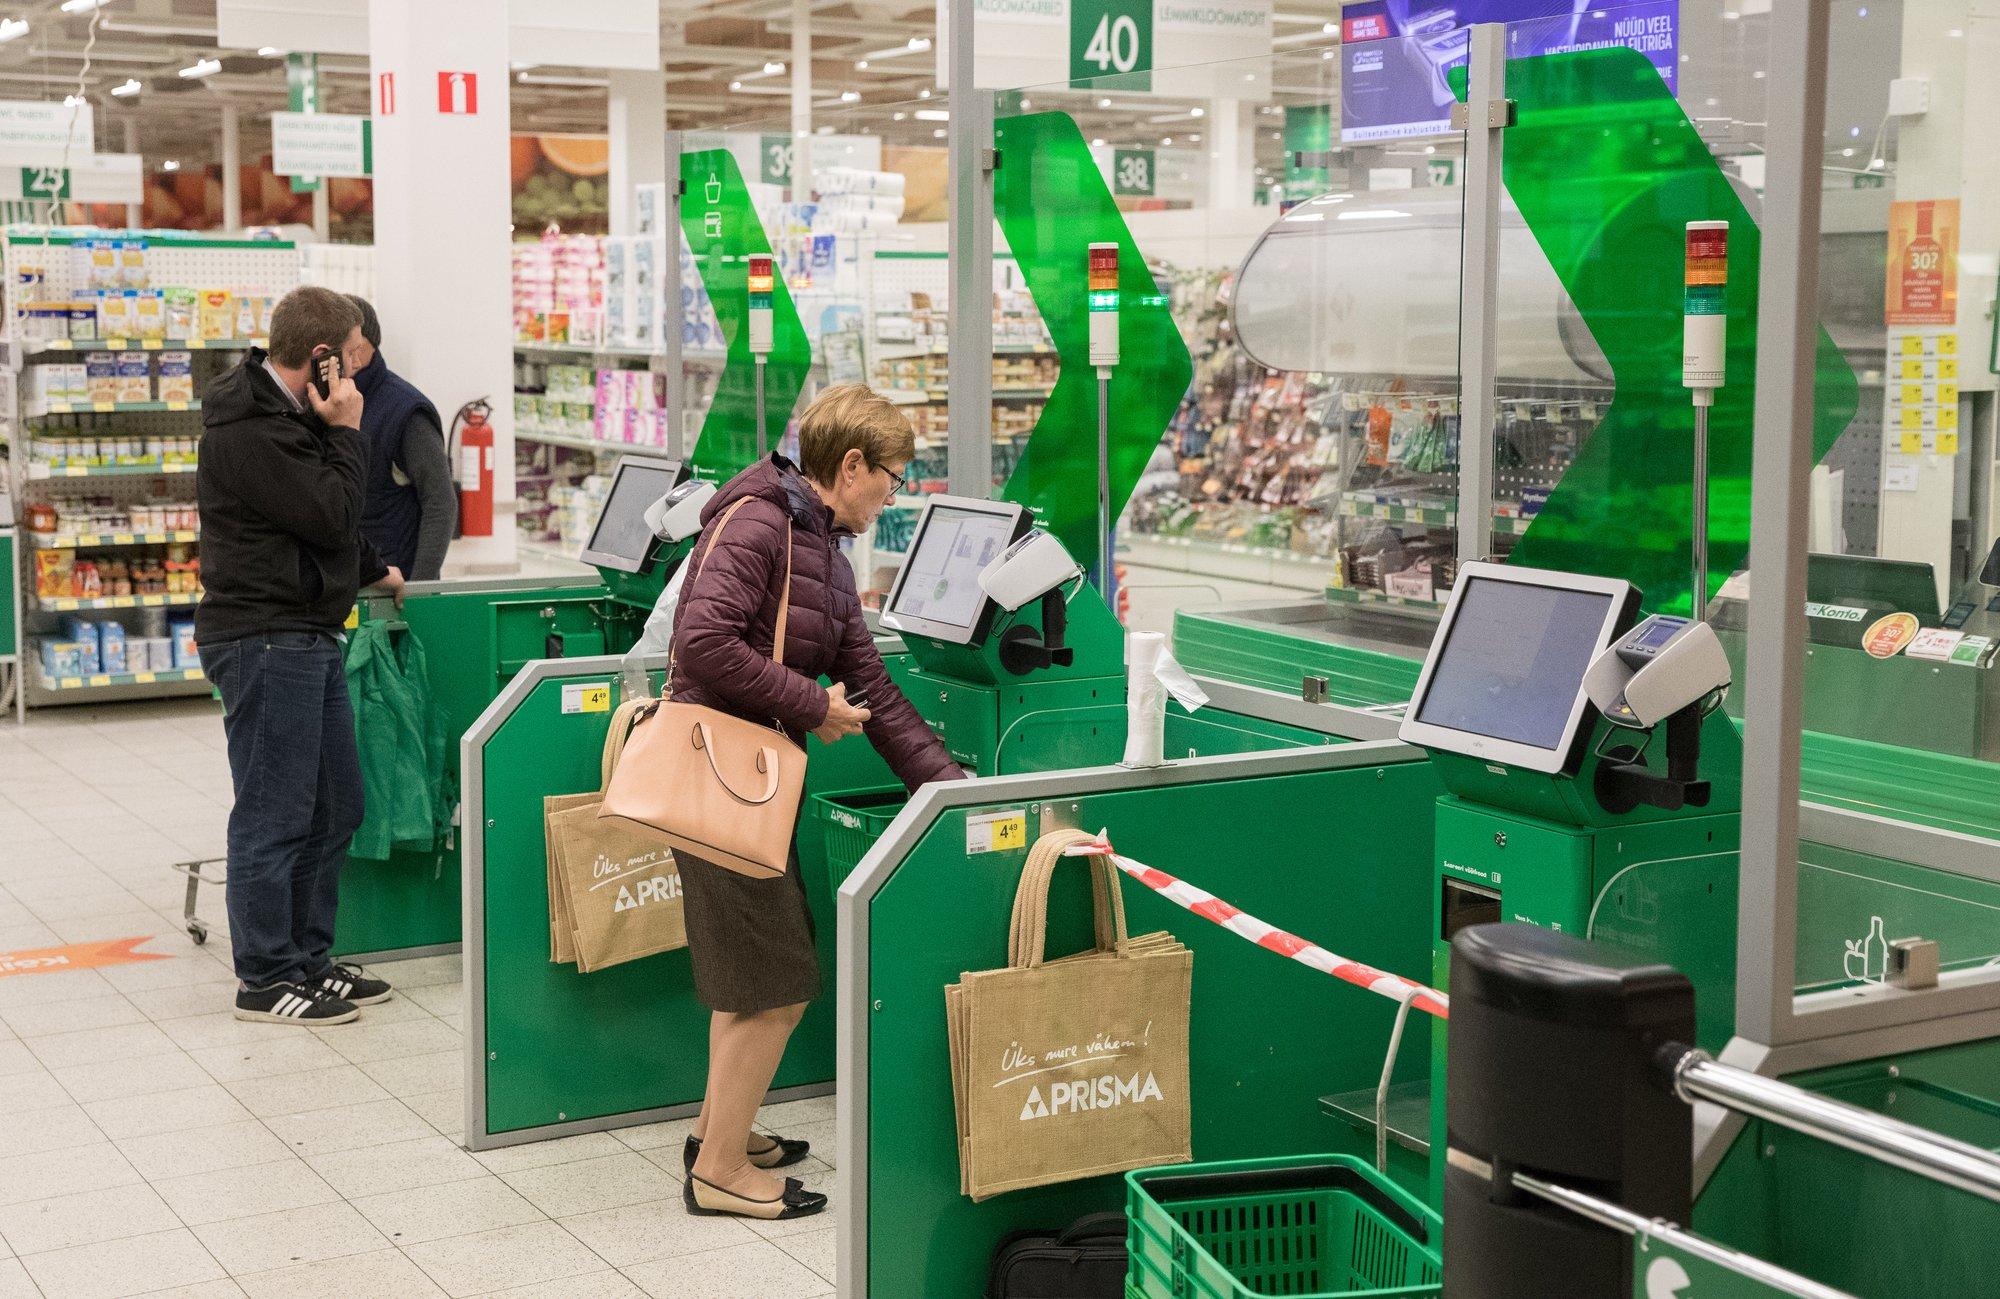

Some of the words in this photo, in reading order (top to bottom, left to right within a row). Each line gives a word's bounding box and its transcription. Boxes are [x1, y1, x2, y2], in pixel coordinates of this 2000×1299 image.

[1084, 13, 1139, 72] 40
[1614, 17, 1645, 38] NÜÜD
[1646, 15, 1673, 34] VEEL
[1628, 32, 1673, 53] FILTRIGA
[1120, 157, 1149, 190] 38
[1911, 252, 1939, 270] 30?
[1001, 1040, 1036, 1072] Üks
[1045, 1045, 1077, 1062] mure
[1051, 1070, 1165, 1116] PRISMA
